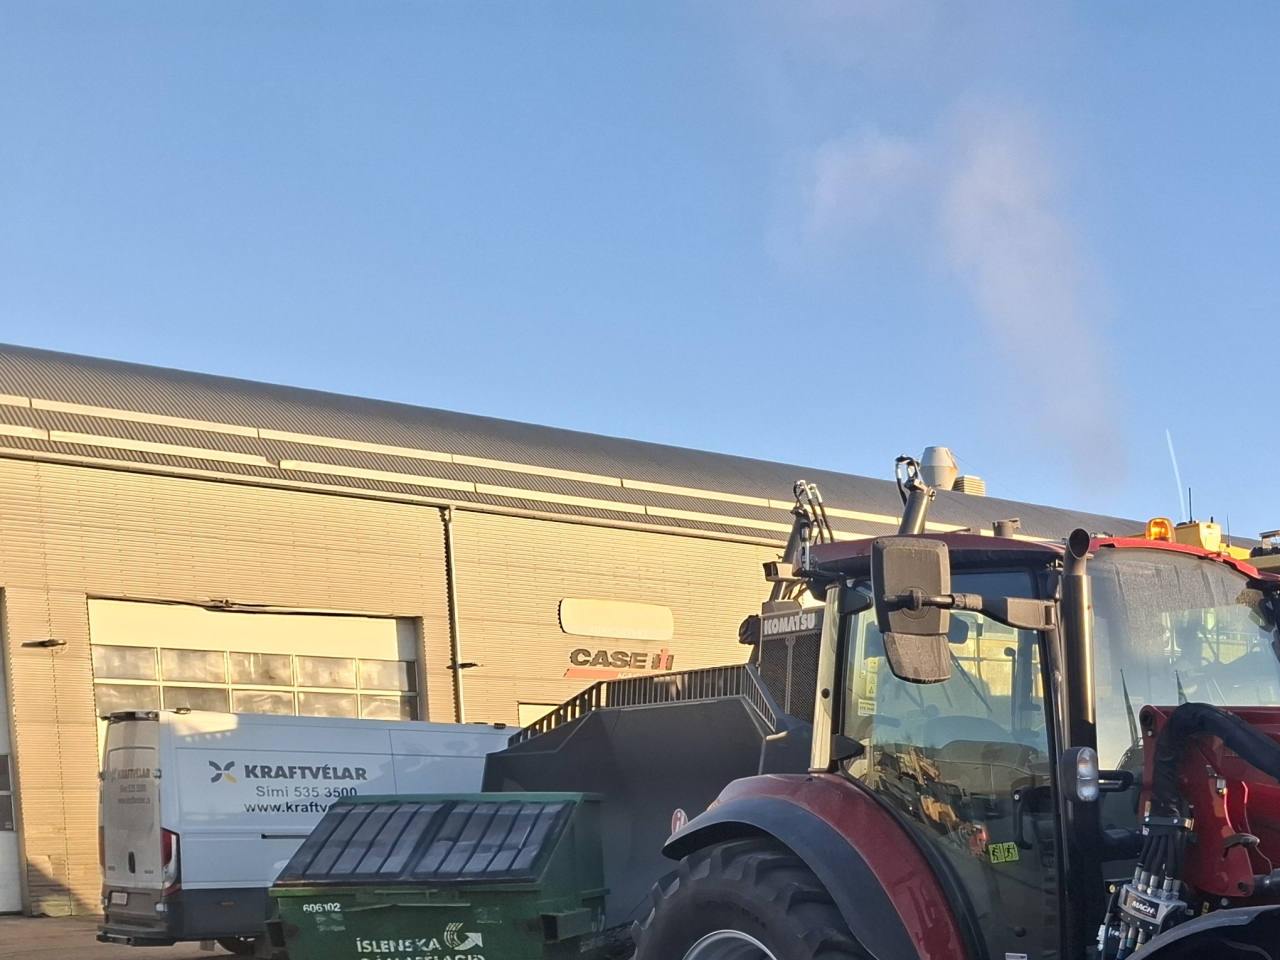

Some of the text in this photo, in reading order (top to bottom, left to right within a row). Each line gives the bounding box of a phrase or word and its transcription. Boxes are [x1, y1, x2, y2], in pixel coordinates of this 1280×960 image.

[764, 610, 816, 635] KOMATSU
[588, 625, 648, 637] AGRICULTURE
[569, 648, 648, 669] CASE
[244, 764, 368, 781] KRAFTVÉLAR
[255, 785, 357, 798] Sími 535 3500
[356, 937, 442, 953] ÍSLENSKA
